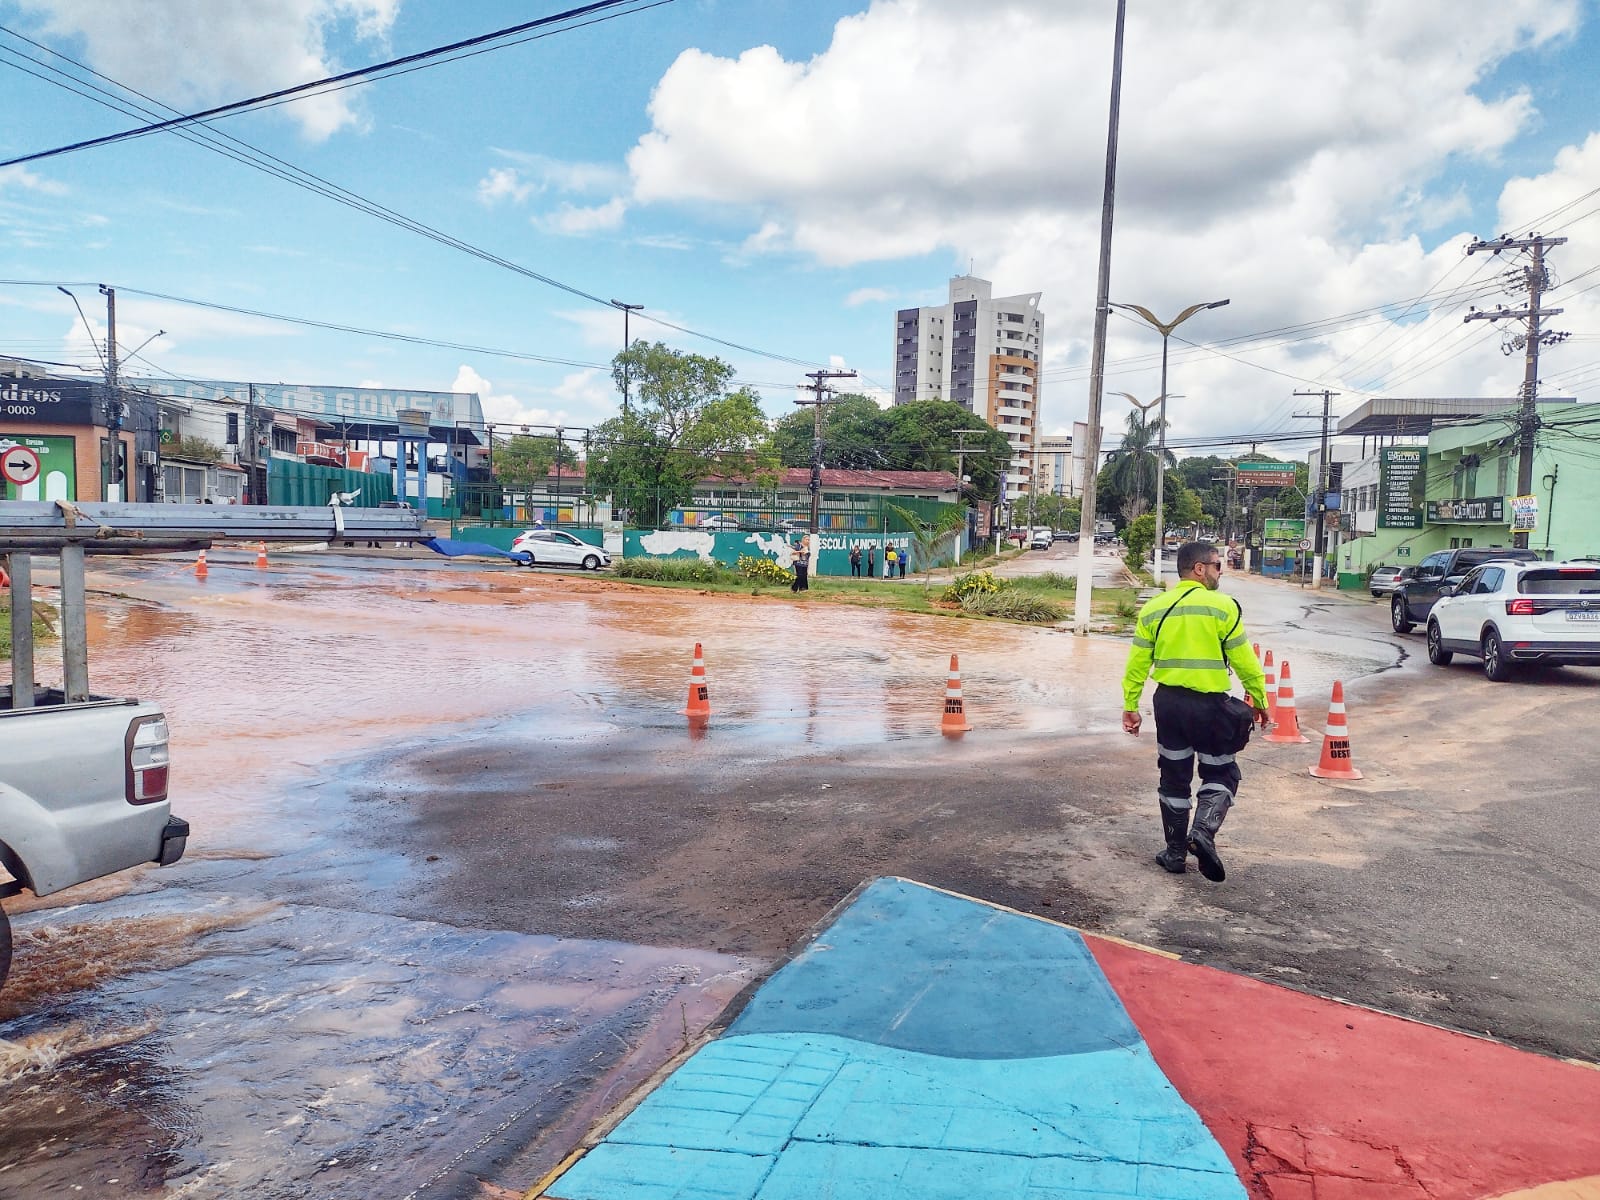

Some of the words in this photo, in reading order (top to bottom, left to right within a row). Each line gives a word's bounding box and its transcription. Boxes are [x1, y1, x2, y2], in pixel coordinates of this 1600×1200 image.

[0, 383, 61, 403] dros
[0, 405, 36, 415] -0003
[819, 537, 847, 550] ESCOLA
[944, 706, 962, 714] OESTE
[1330, 749, 1350, 759] OEST
